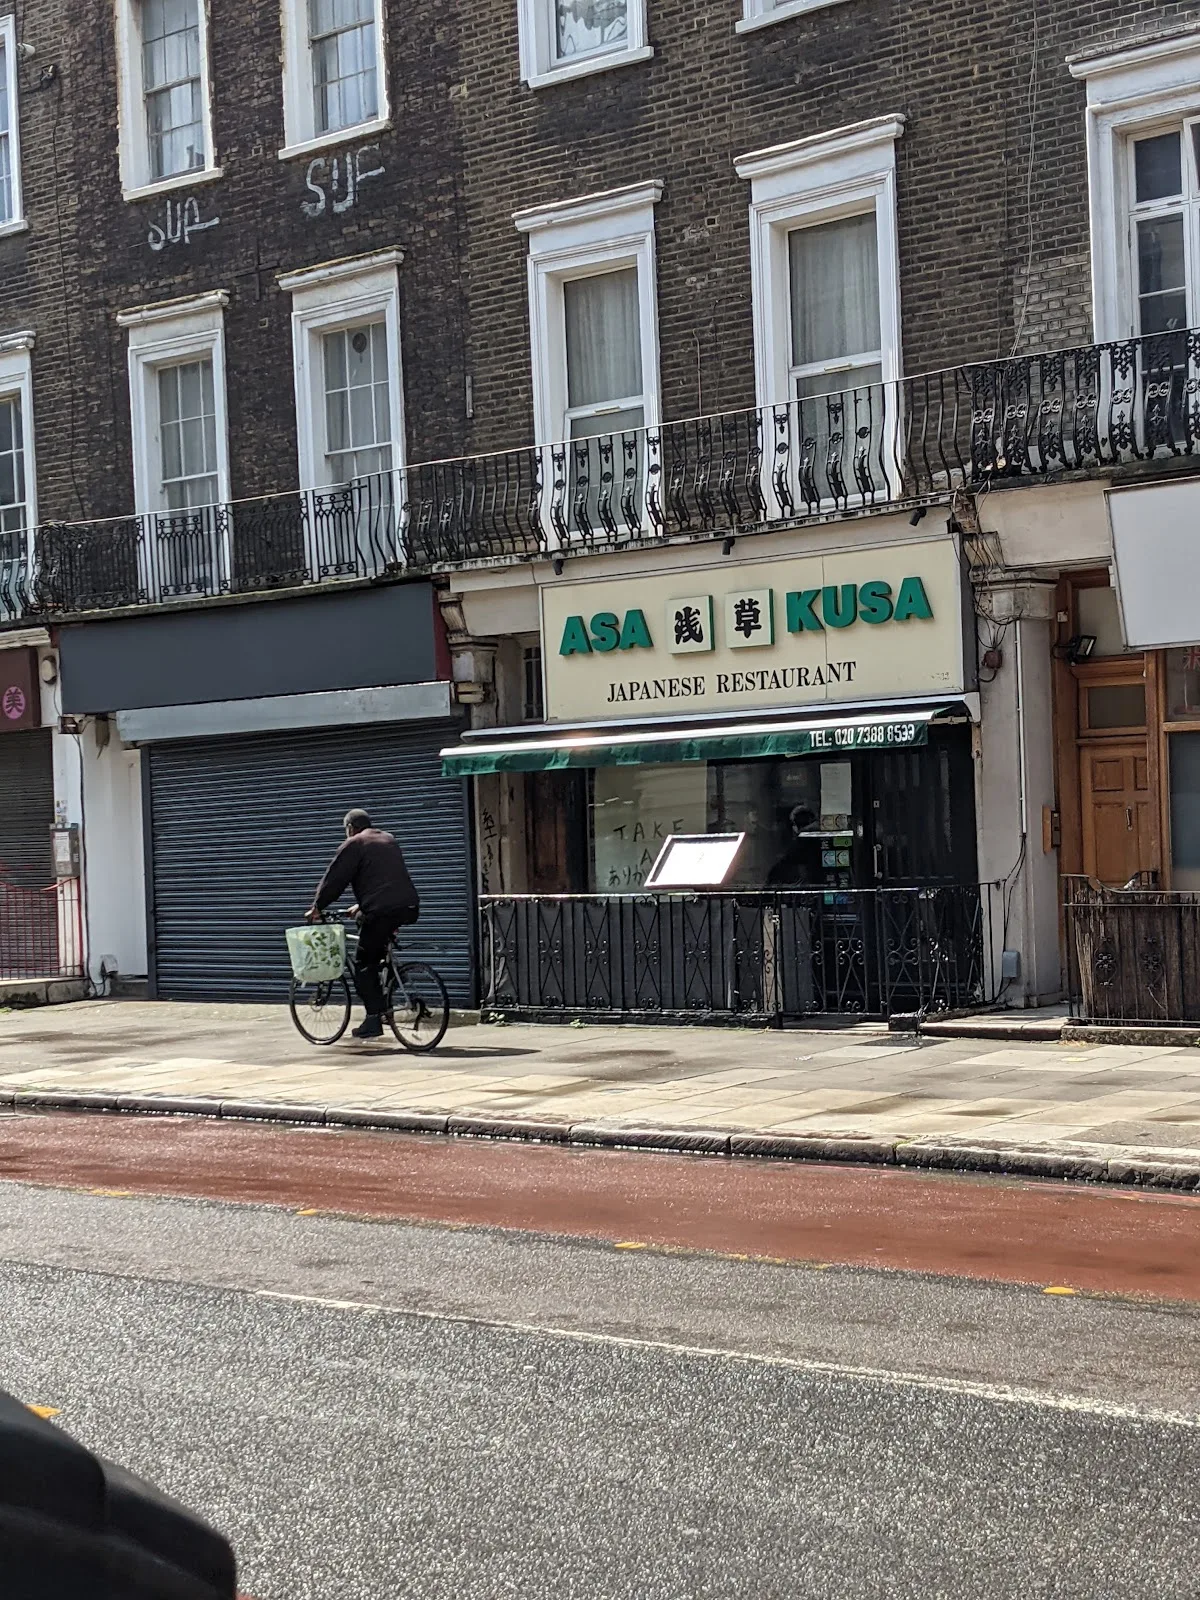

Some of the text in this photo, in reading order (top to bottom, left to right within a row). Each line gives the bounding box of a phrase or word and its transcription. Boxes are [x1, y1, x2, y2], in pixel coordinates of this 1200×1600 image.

[559, 609, 653, 656] ASA
[786, 576, 933, 634] KUSA
[607, 661, 857, 703] JAPANESE RESTAURANT
[834, 729, 854, 745] 020
[856, 725, 885, 744] 7388
